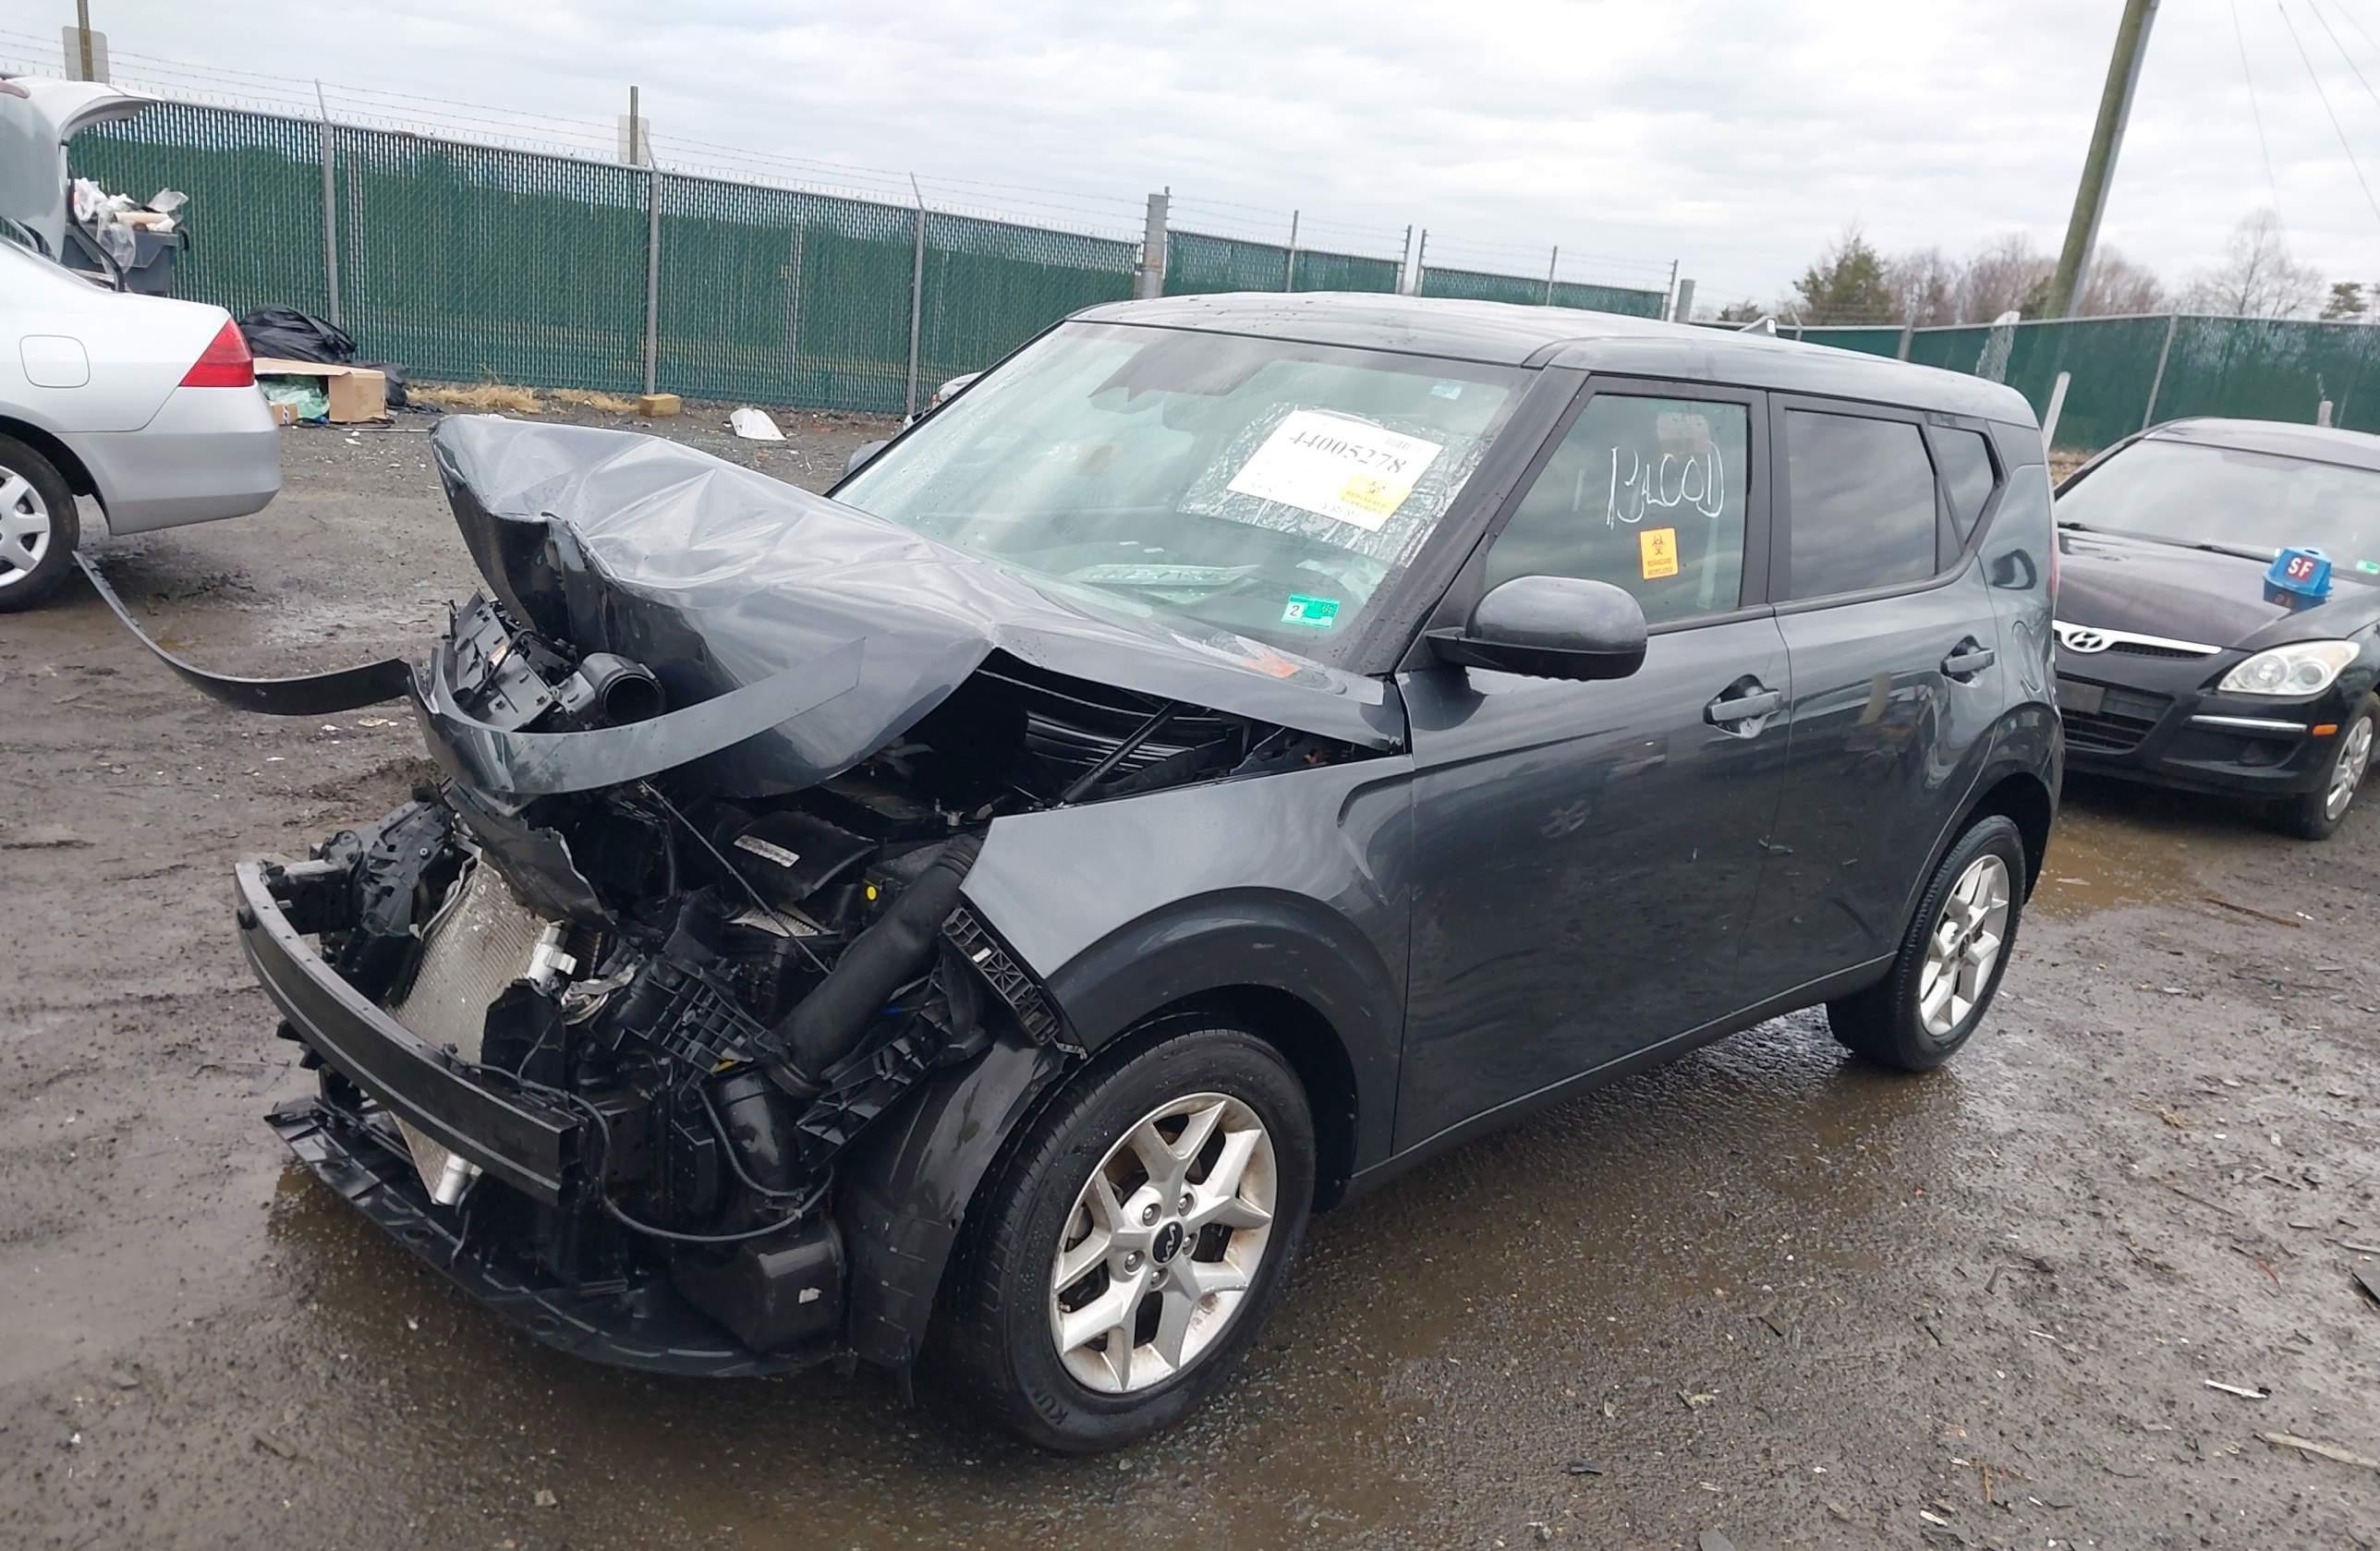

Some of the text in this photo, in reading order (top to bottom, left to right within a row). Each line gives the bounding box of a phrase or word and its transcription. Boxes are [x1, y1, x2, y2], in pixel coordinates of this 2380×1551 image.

[1289, 430, 1407, 473] 44005278
[2288, 557, 2313, 577] SF
[1290, 605, 1300, 617] 2
